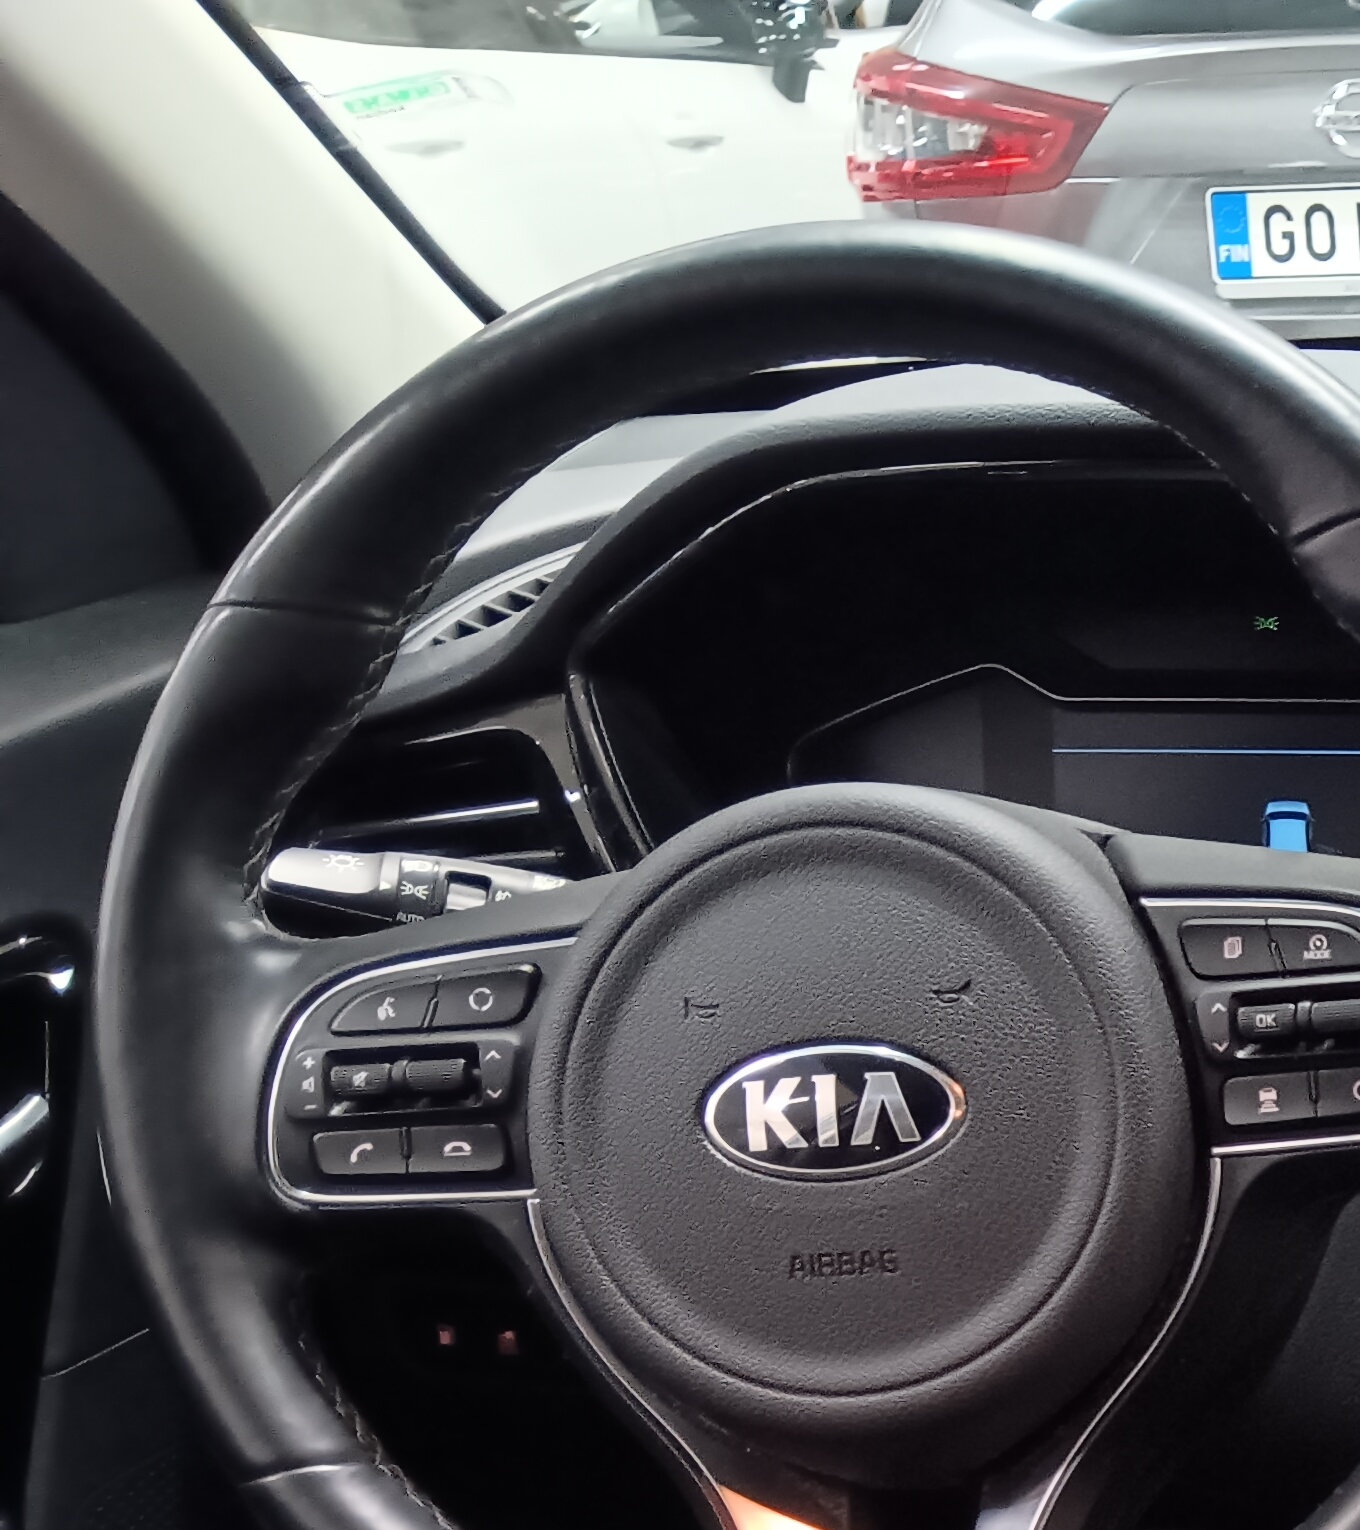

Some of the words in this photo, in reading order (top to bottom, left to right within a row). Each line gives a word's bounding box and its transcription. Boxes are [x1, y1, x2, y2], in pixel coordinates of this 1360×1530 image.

[1218, 244, 1249, 262] FIN
[1255, 1013, 1277, 1028] OK
[742, 1071, 922, 1152] KIA
